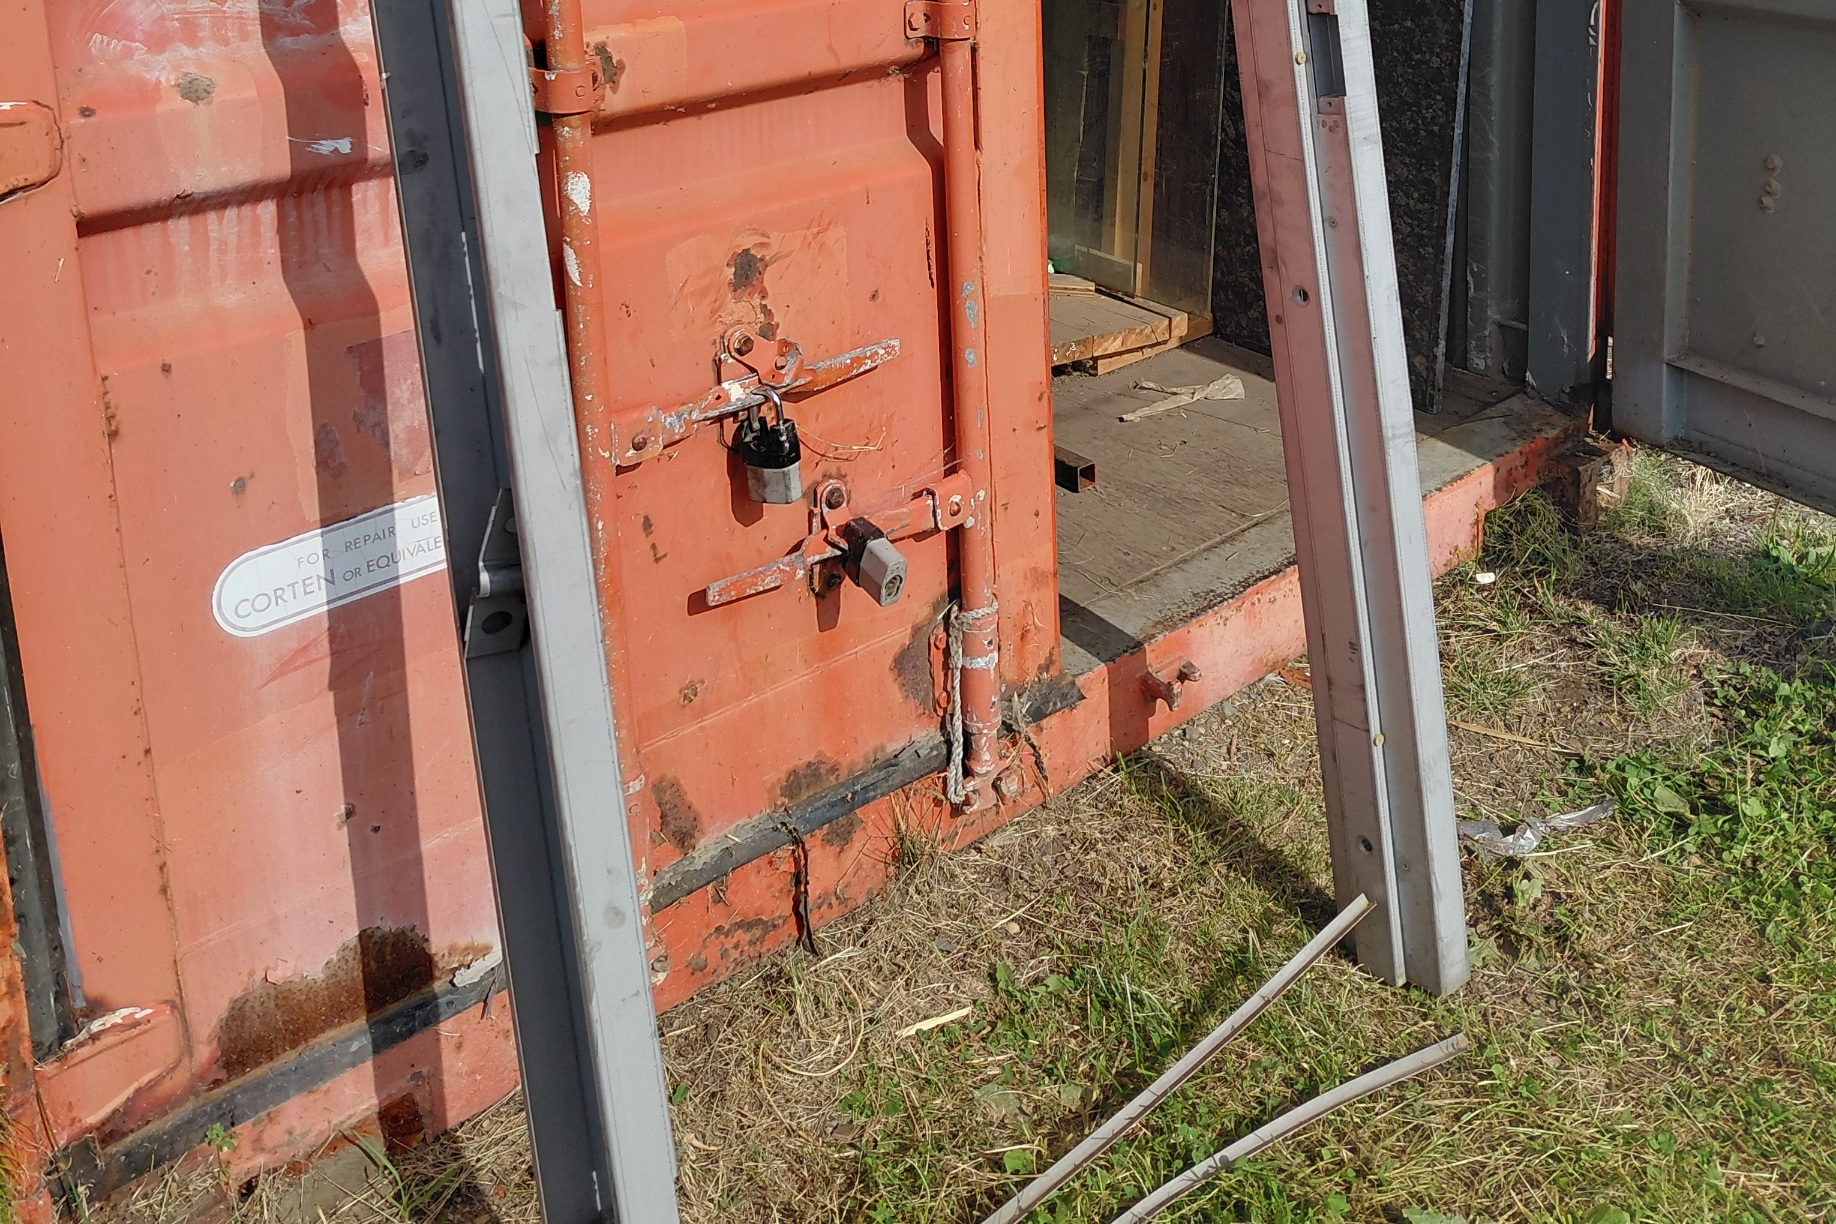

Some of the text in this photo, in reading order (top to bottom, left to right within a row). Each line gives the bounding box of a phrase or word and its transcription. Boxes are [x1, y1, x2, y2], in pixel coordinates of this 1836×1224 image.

[297, 511, 438, 569] FOR REPAIR USE
[233, 536, 442, 620] CORTEN OR EQUIVALE
